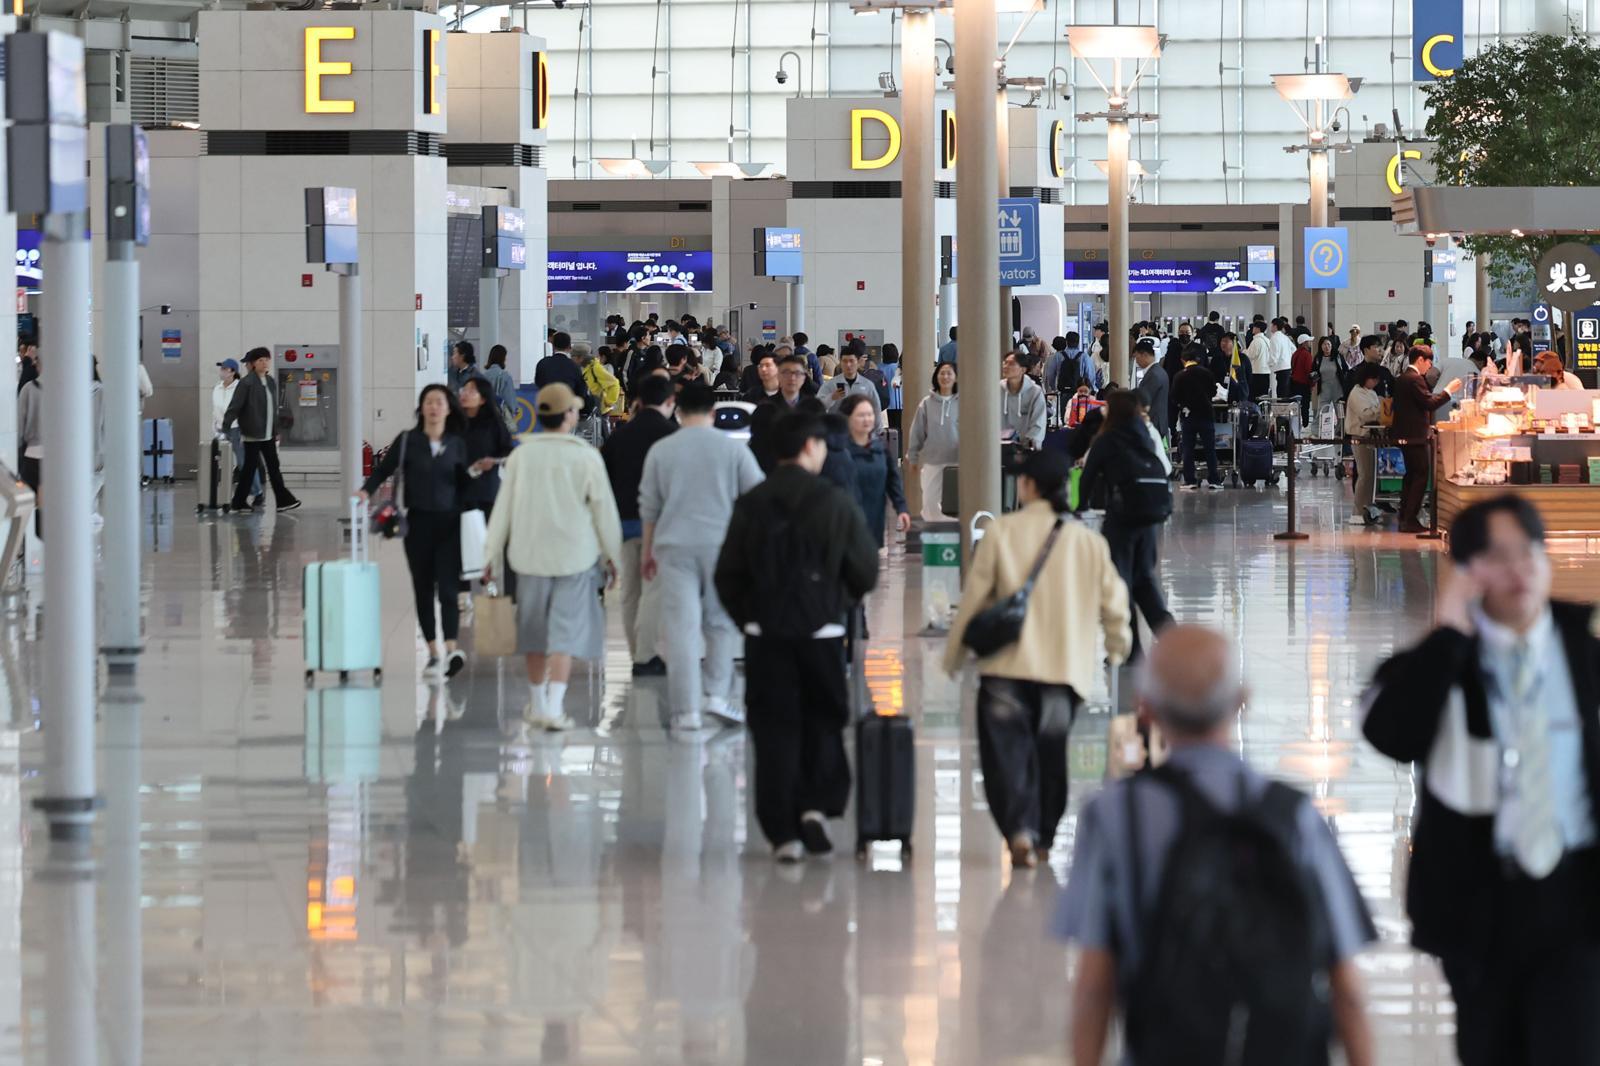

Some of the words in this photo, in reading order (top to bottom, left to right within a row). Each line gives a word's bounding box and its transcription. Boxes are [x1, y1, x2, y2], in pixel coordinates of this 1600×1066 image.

[304, 26, 355, 114] E
[1422, 34, 1454, 77] C
[850, 108, 902, 170] D
[671, 237, 686, 248] D1
[999, 268, 1036, 280] vators
[1545, 261, 1597, 293] 빚은
